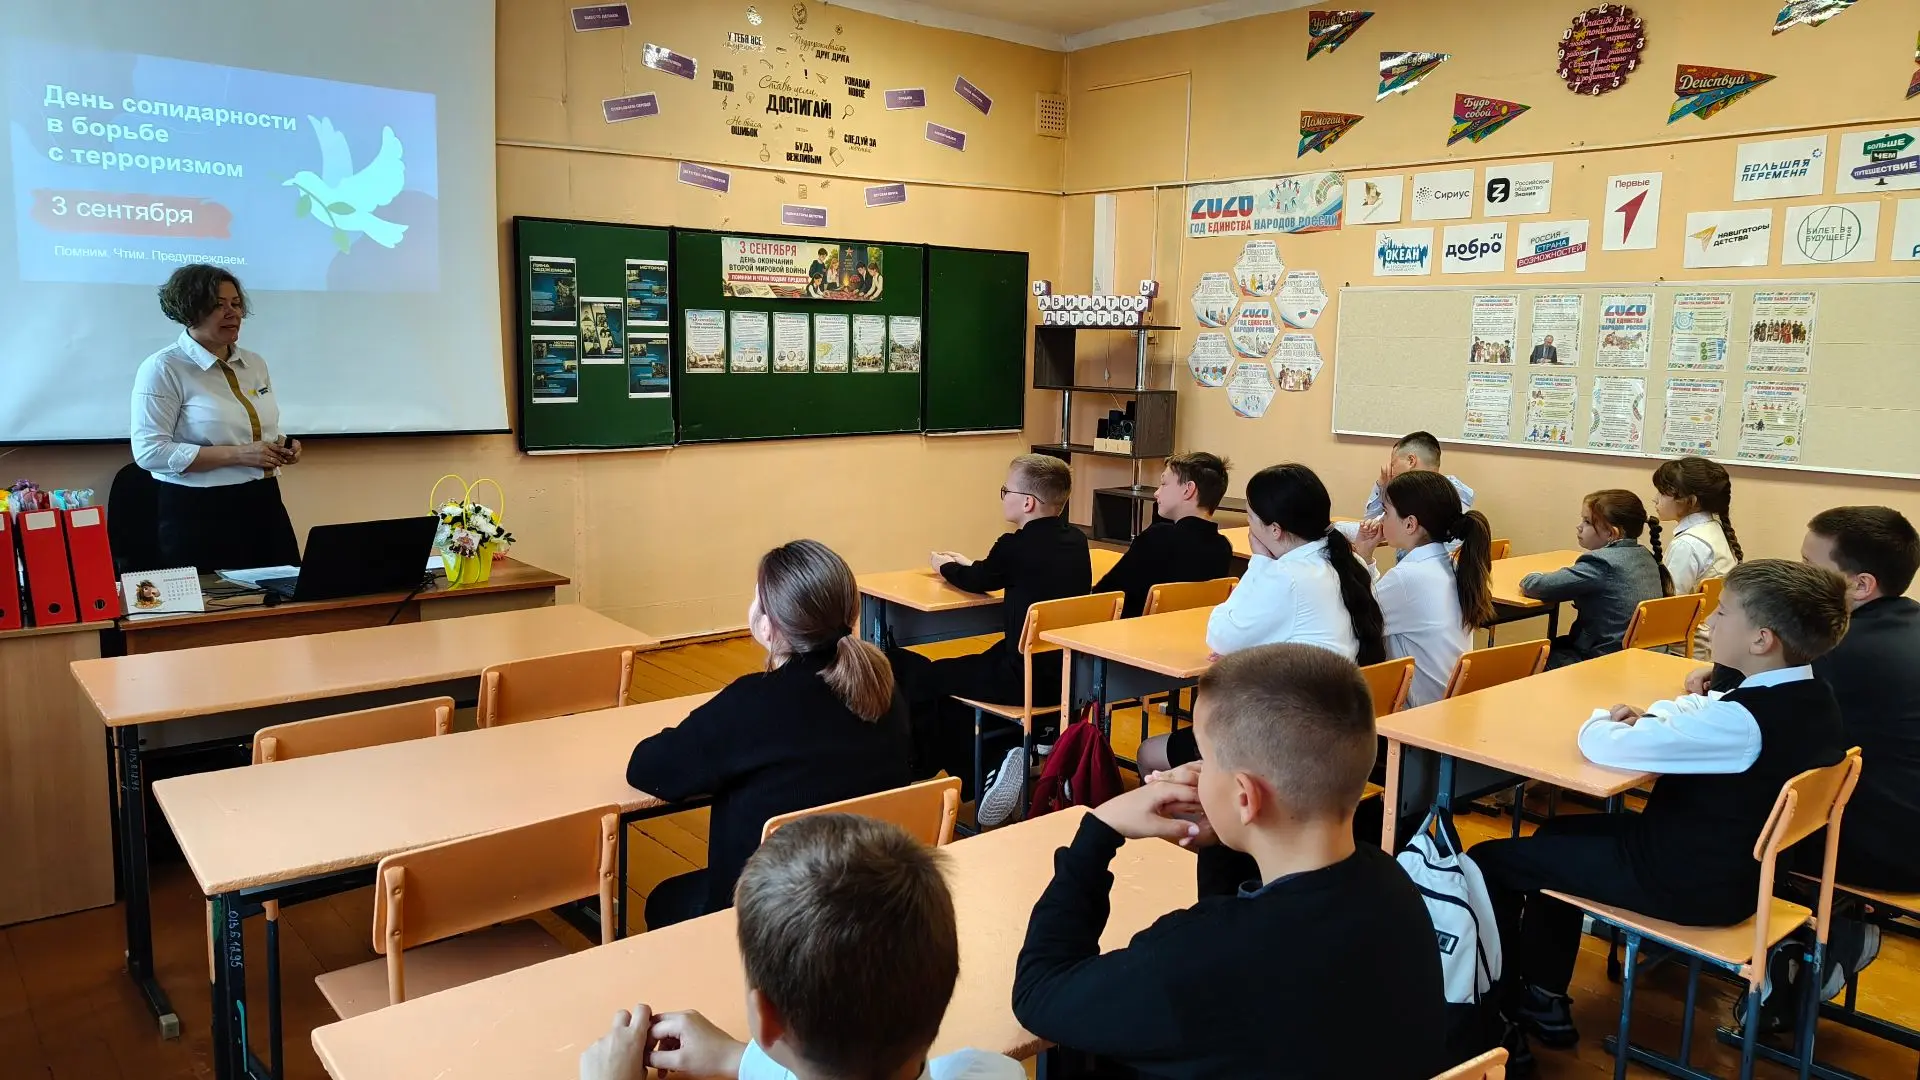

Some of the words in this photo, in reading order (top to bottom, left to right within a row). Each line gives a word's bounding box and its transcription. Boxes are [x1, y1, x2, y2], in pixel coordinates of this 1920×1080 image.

[1599, 3, 1609, 14] 12
[1620, 5, 1626, 16] 1
[1579, 12, 1586, 23] 11
[1634, 18, 1641, 29] 2
[734, 32, 750, 43] ТЕБЯ
[750, 35, 762, 45] ВСЕ
[1562, 29, 1572, 39] 10
[1637, 38, 1644, 48] 3
[816, 50, 830, 60] ДРУГ
[831, 53, 850, 63] ДРУГА
[1558, 49, 1565, 59] 9
[1628, 59, 1635, 70] 4
[713, 69, 734, 81] УЧИСЬ
[1561, 68, 1568, 78] 8
[758, 75, 792, 91] Ставь
[844, 76, 870, 89] УЗНАВАЙ
[1574, 81, 1581, 92] 7
[1612, 77, 1620, 87] 5
[1679, 74, 1745, 90] Действуй
[848, 87, 865, 98] НОВОЕ
[1592, 84, 1600, 95] 6
[43, 84, 114, 110] День
[122, 97, 298, 131] солидарности
[766, 94, 832, 119] ДОСТИГАЙ!
[1464, 97, 1490, 108] Будь
[1465, 109, 1491, 119] собой
[726, 116, 741, 125] Не
[1301, 115, 1341, 129] Помогай
[47, 119, 64, 133] в
[72, 116, 169, 144] борьбе
[731, 126, 758, 137] ОШИБОК
[844, 134, 868, 146] СЛЕДУЙ
[869, 138, 877, 147] ЗА
[1867, 138, 1906, 151] БОЛЬШЕ
[795, 141, 813, 153] БУДЬ
[786, 152, 822, 165] ВЕЖЛИВЫМ
[1873, 152, 1896, 160] ЧЕМ
[48, 147, 63, 161] с
[71, 148, 244, 178] терроризмом
[1743, 158, 1811, 173] БОЛЬШАЯ
[1854, 160, 1918, 177] ПУТЕШЕСТВИЕ
[1741, 168, 1808, 182] ПЕРЕМЕНА
[1615, 178, 1650, 189] Первые
[1434, 188, 1470, 201] Сириус
[52, 196, 68, 216] 3
[76, 200, 194, 227] сентября
[1190, 223, 1206, 234] ГОД
[1208, 220, 1251, 234] ЕДИНСТВА
[1254, 217, 1296, 231] НАРОДОВ
[1299, 214, 1339, 227] РОССИИ
[1490, 232, 1503, 240] .ru
[1717, 223, 1770, 239] НАВИГАТОРЫ
[1530, 231, 1561, 244] РОССИЯ
[1713, 234, 1749, 246] ДЕТСТВА
[740, 241, 746, 254] 3
[750, 242, 797, 256] СЕНТЯБРЯ
[1446, 238, 1502, 258] добро
[1536, 238, 1568, 253] СТРАНА
[54, 246, 109, 258] Помним.
[114, 248, 148, 260] Чтим.
[152, 250, 248, 266] Предупреждаем.
[1386, 248, 1420, 260] ОКЕАН
[1518, 243, 1583, 267] ВОЗМОЖНОСТЕЙ
[758, 257, 794, 265] ОКОНЧАНИЯ
[729, 263, 753, 271] ВТОРОЙ
[755, 265, 784, 273] МИРОВОЙ
[786, 266, 806, 274] ВОЙНЫ
[1045, 313, 1133, 322] ДЕТСТВА
